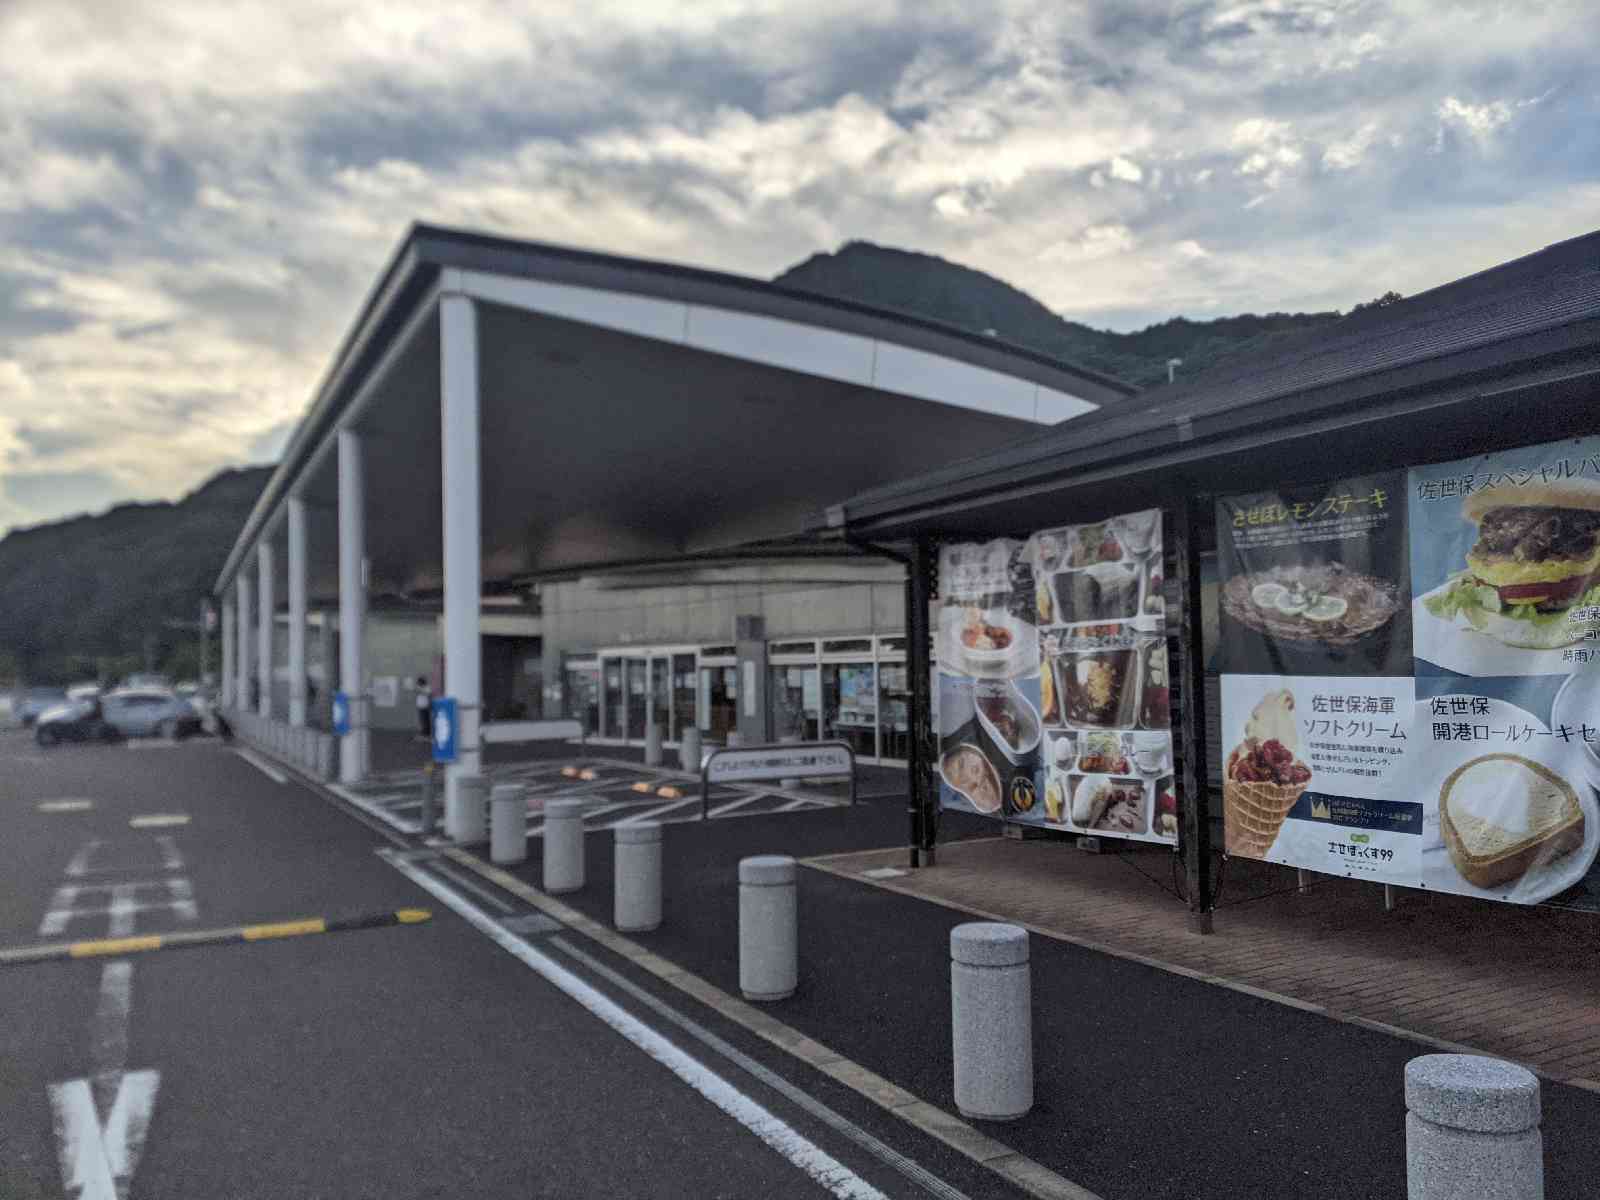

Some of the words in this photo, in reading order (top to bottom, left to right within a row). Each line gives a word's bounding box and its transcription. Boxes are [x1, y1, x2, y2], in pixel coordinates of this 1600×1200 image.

[1311, 695, 1396, 714] 佐世保海軍
[1431, 697, 1491, 716] 佐世保
[1303, 719, 1408, 740] ソフトクリーム
[1432, 722, 1598, 743] 開港ロールケーキセ
